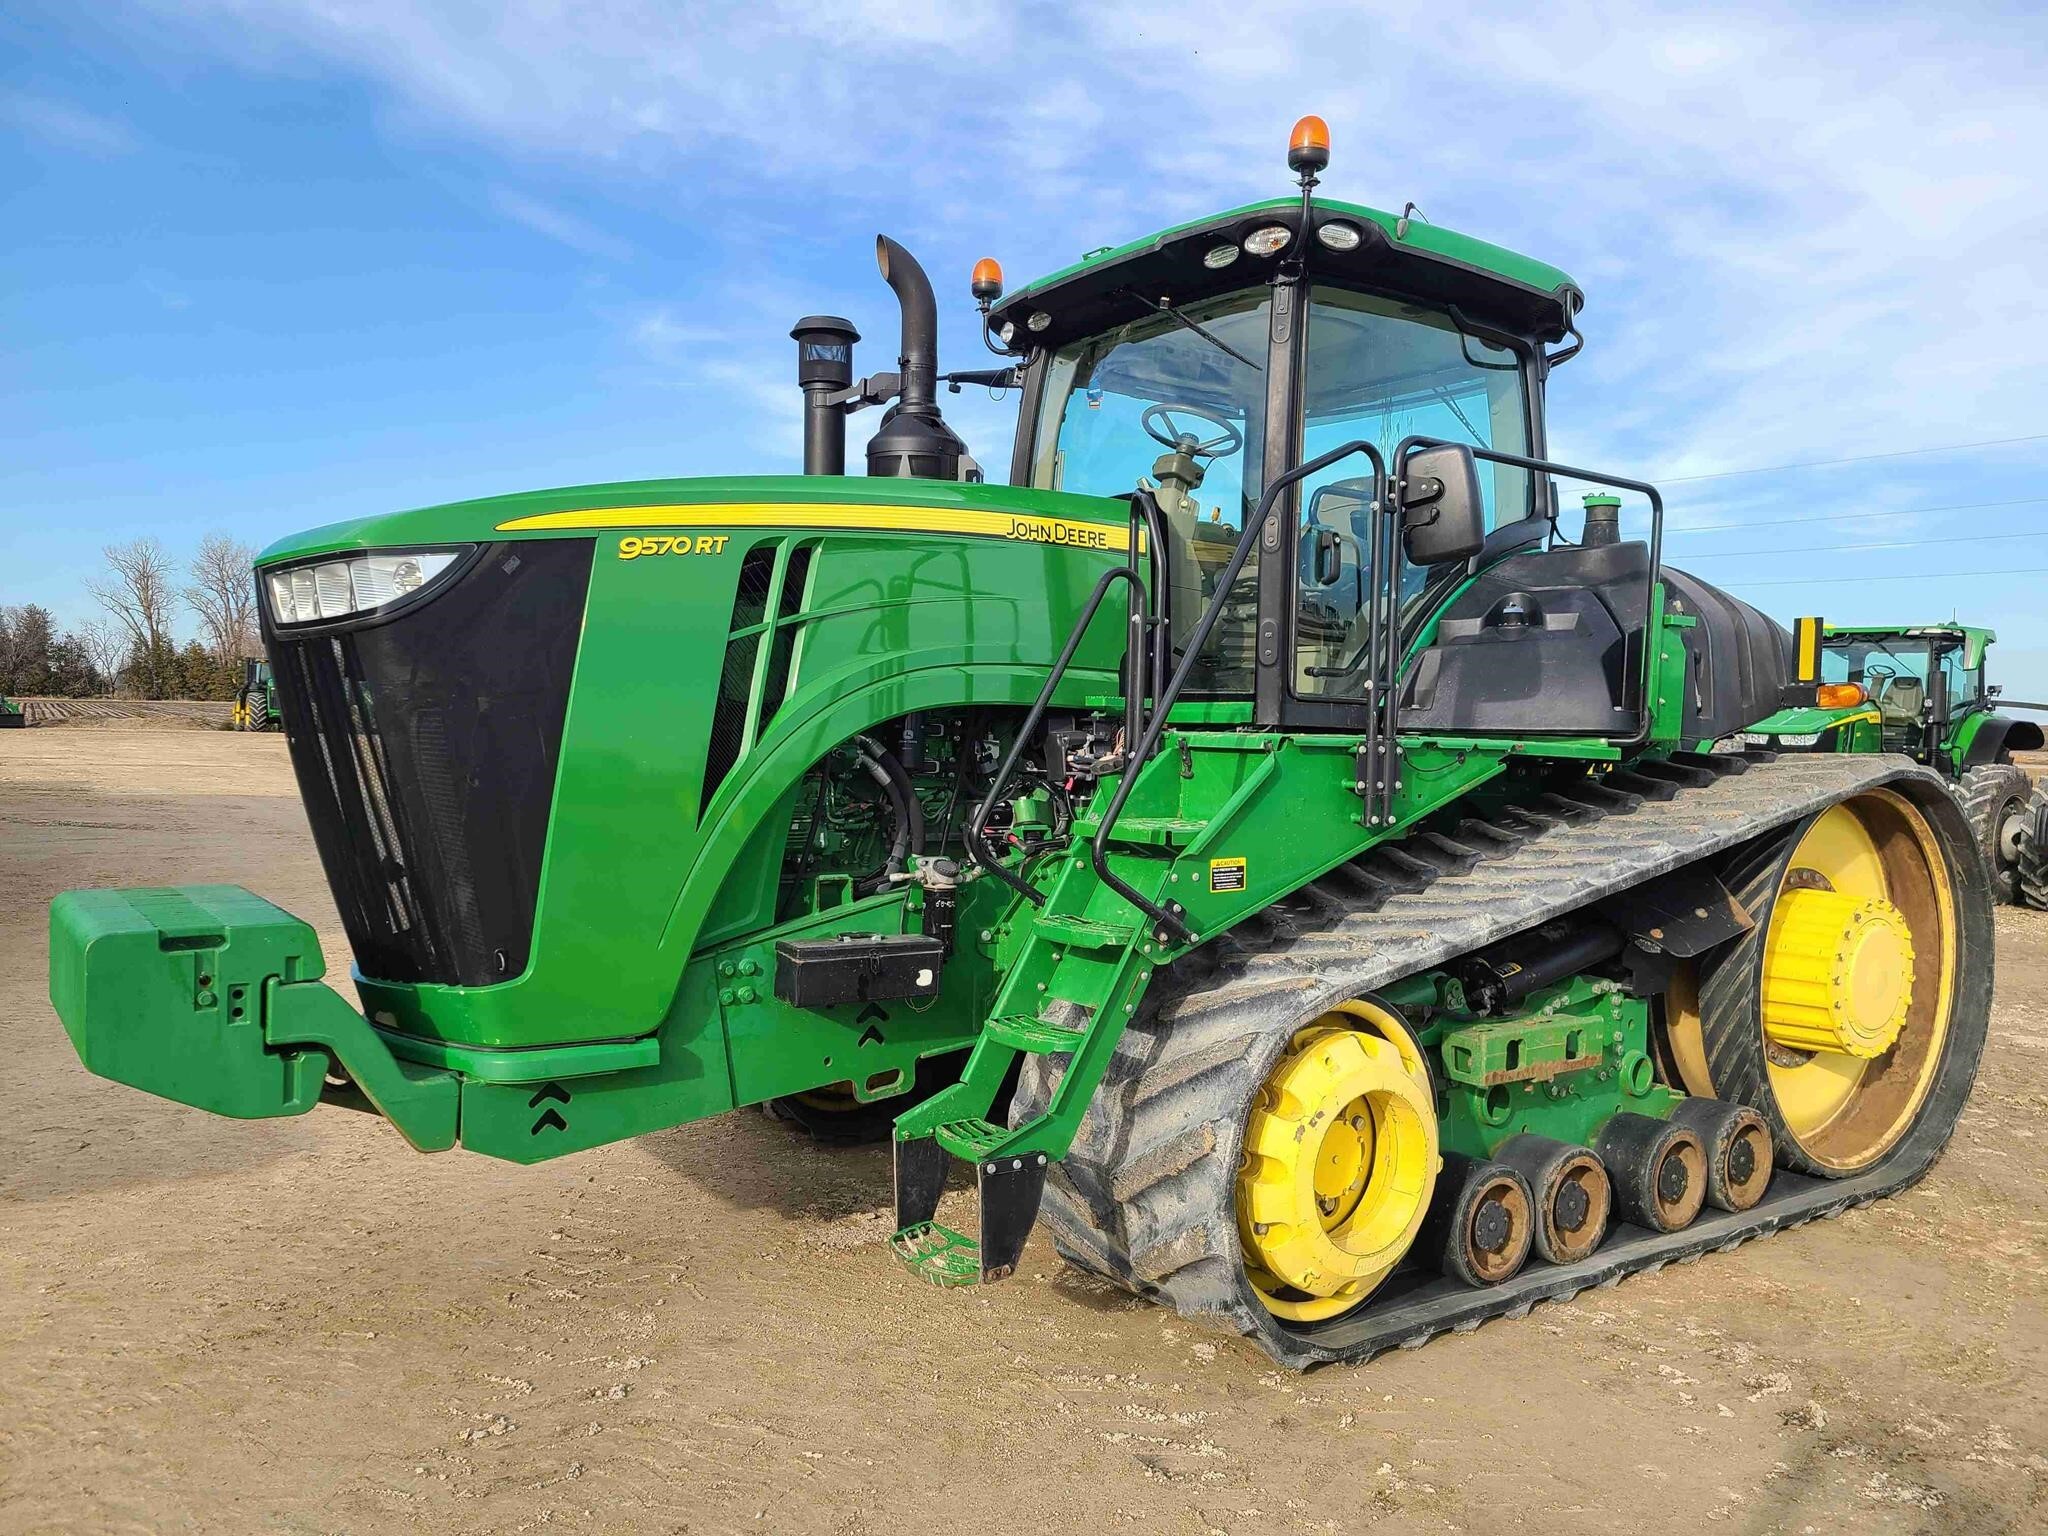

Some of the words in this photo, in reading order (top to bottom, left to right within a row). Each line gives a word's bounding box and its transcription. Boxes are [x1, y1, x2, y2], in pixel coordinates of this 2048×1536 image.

[1006, 518, 1051, 540] JOHN
[1055, 523, 1107, 547] DEERE
[619, 536, 692, 560] 9570
[695, 536, 730, 555] RT
[1220, 859, 1242, 867] CAUTION
